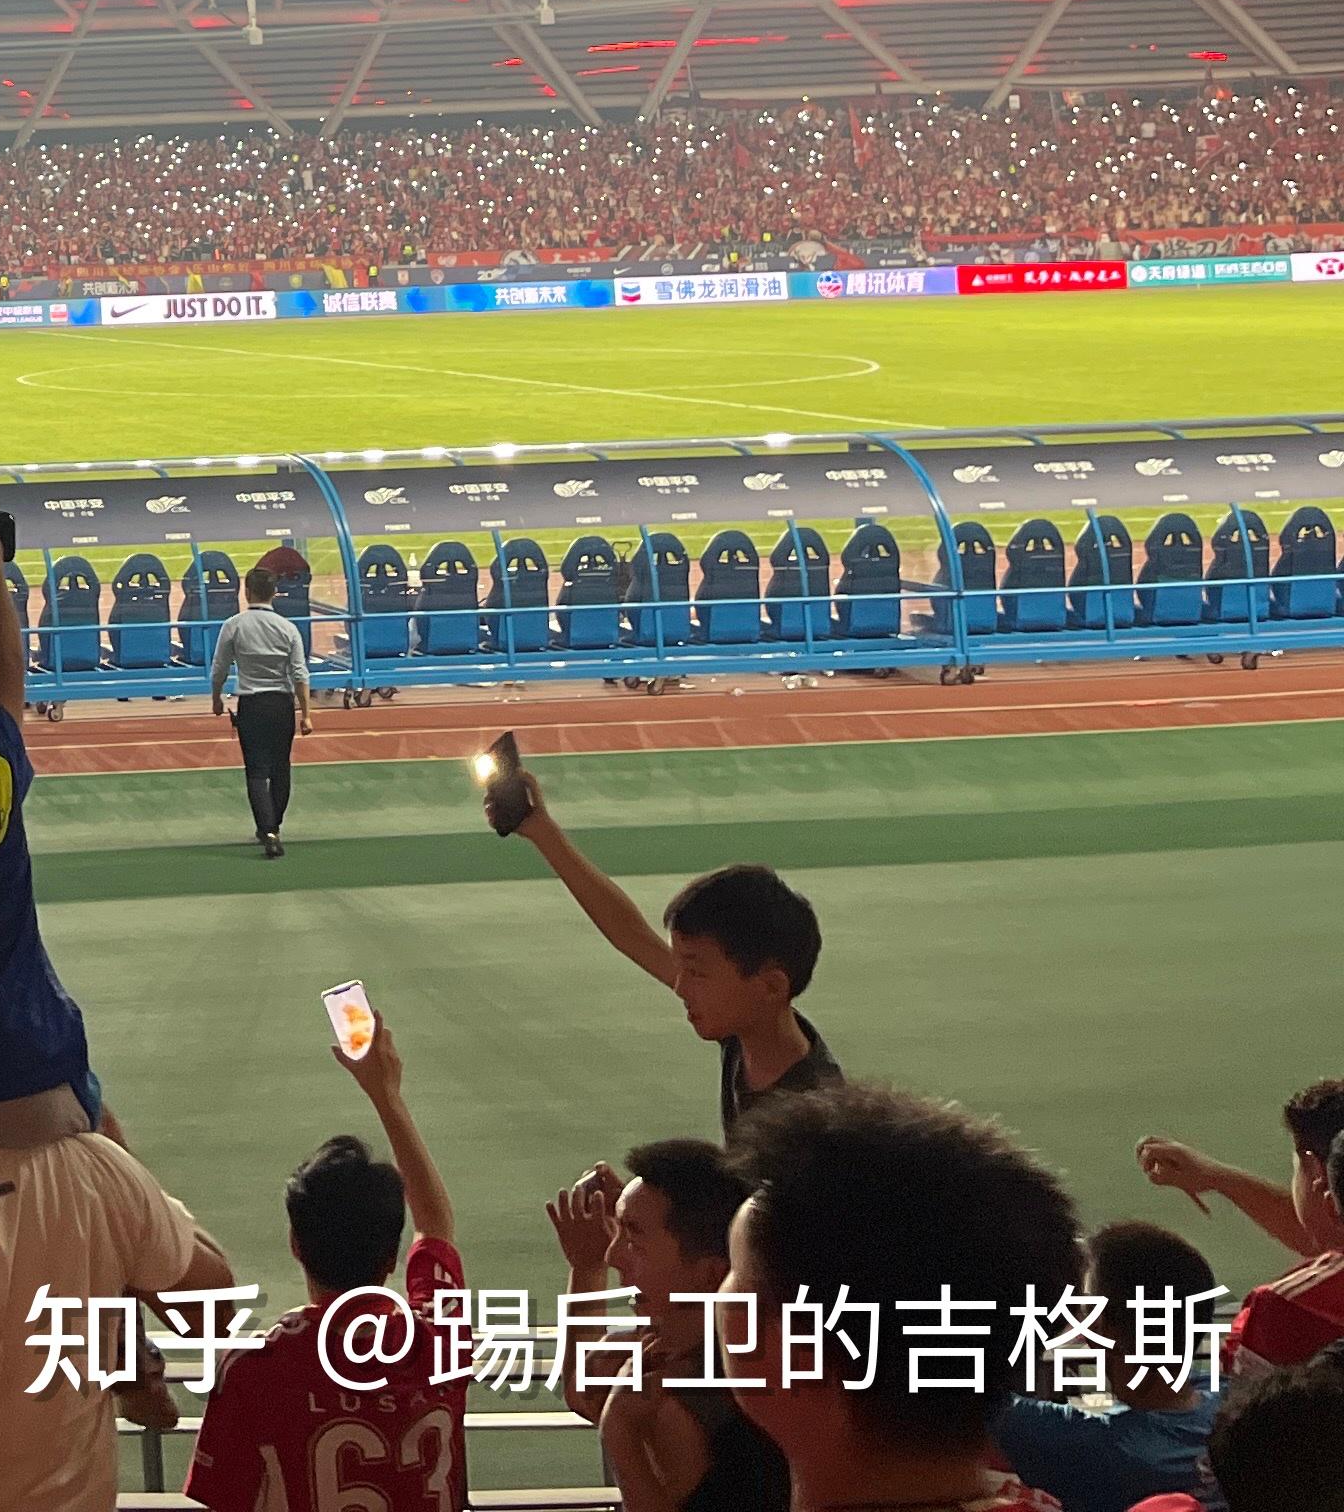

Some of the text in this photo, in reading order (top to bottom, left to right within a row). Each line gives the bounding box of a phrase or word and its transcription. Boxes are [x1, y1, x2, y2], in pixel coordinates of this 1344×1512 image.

[655, 278, 783, 300] 雪佛龙润滑油
[846, 272, 926, 295] 腾讯体育
[323, 291, 398, 313] 诚信联赛
[495, 286, 566, 305] 共创新未来
[163, 295, 268, 319] JUST DO IT.
[236, 490, 296, 503] 中国平安
[448, 482, 510, 495] 中国平安
[44, 498, 104, 510] 中国平安
